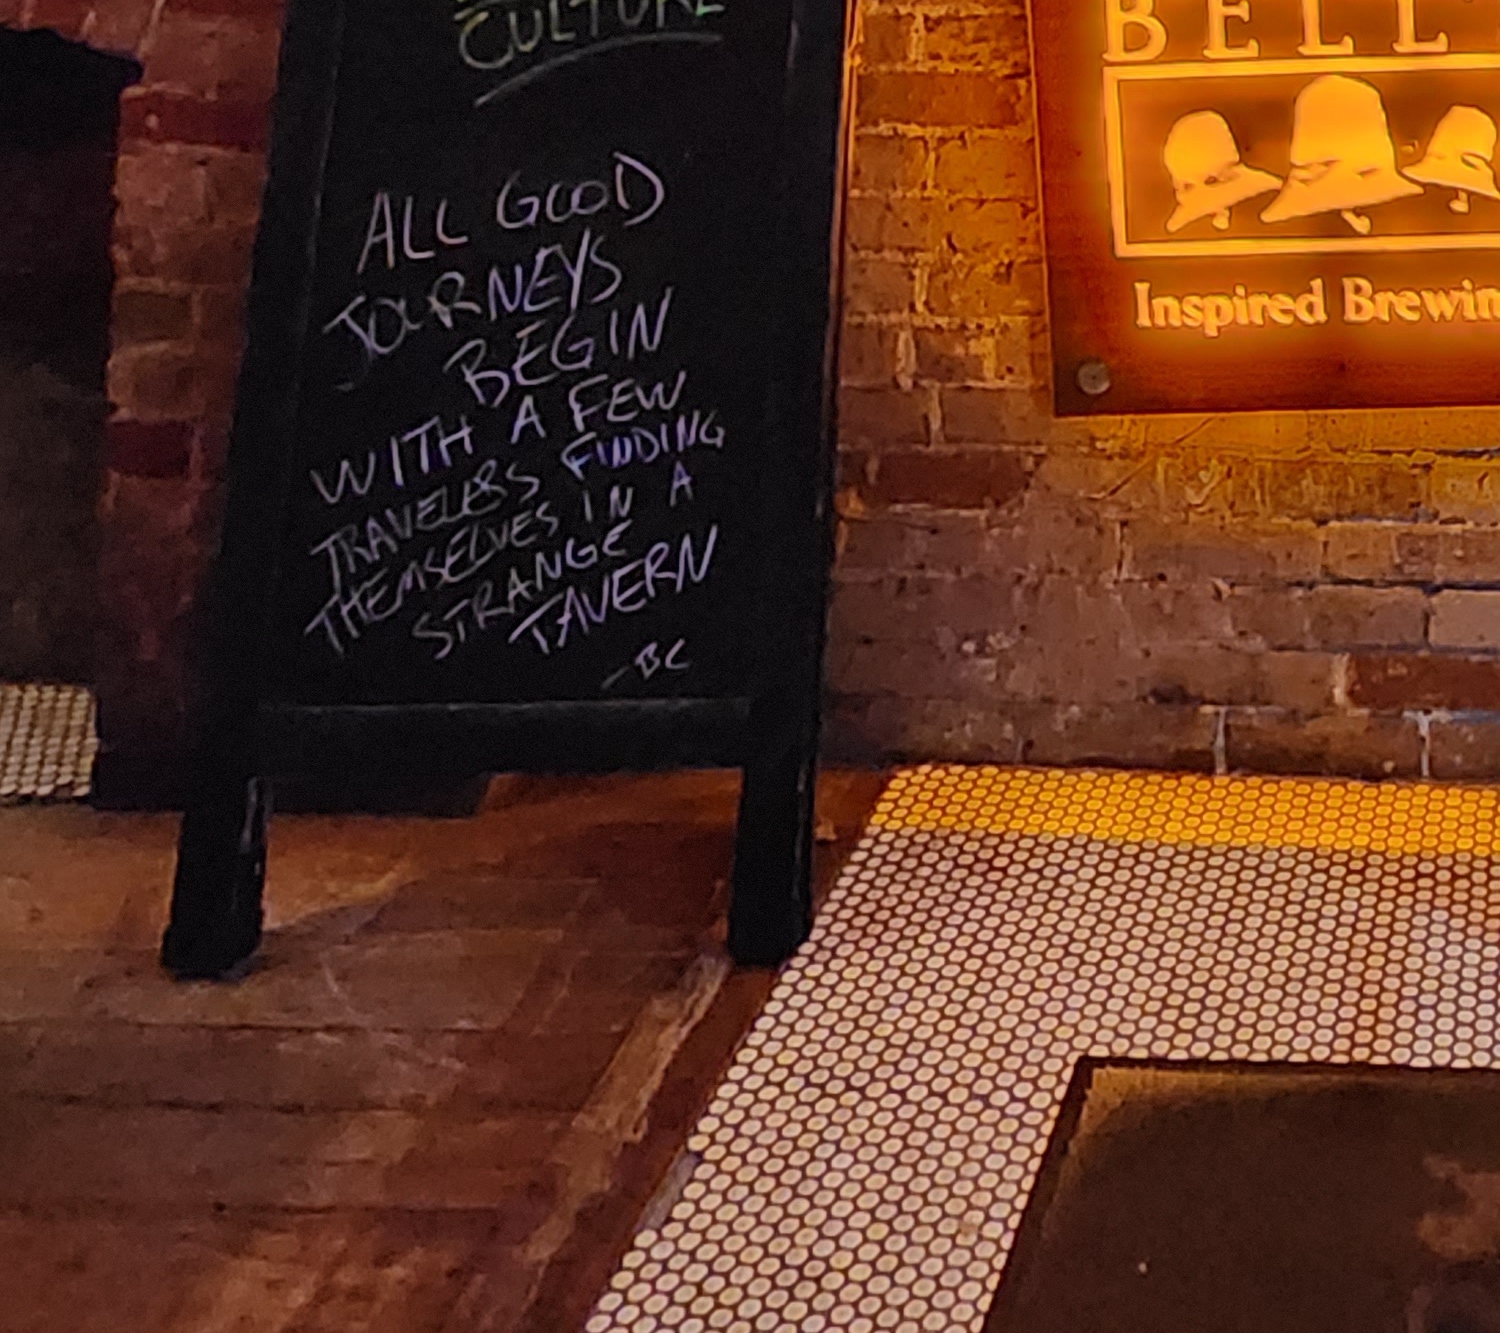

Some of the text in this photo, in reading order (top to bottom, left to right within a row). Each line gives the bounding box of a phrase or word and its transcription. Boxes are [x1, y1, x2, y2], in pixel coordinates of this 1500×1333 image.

[357, 151, 667, 275] ALL GOOD
[443, 286, 675, 410] BEGIN
[1134, 279, 1327, 337] Inspired
[309, 370, 688, 505] WITH A FEW
[560, 408, 728, 481] FINDING
[304, 459, 695, 659] THEMSELVES IN A
[412, 518, 634, 661] STRANGE
[508, 523, 720, 655] TAVERN
